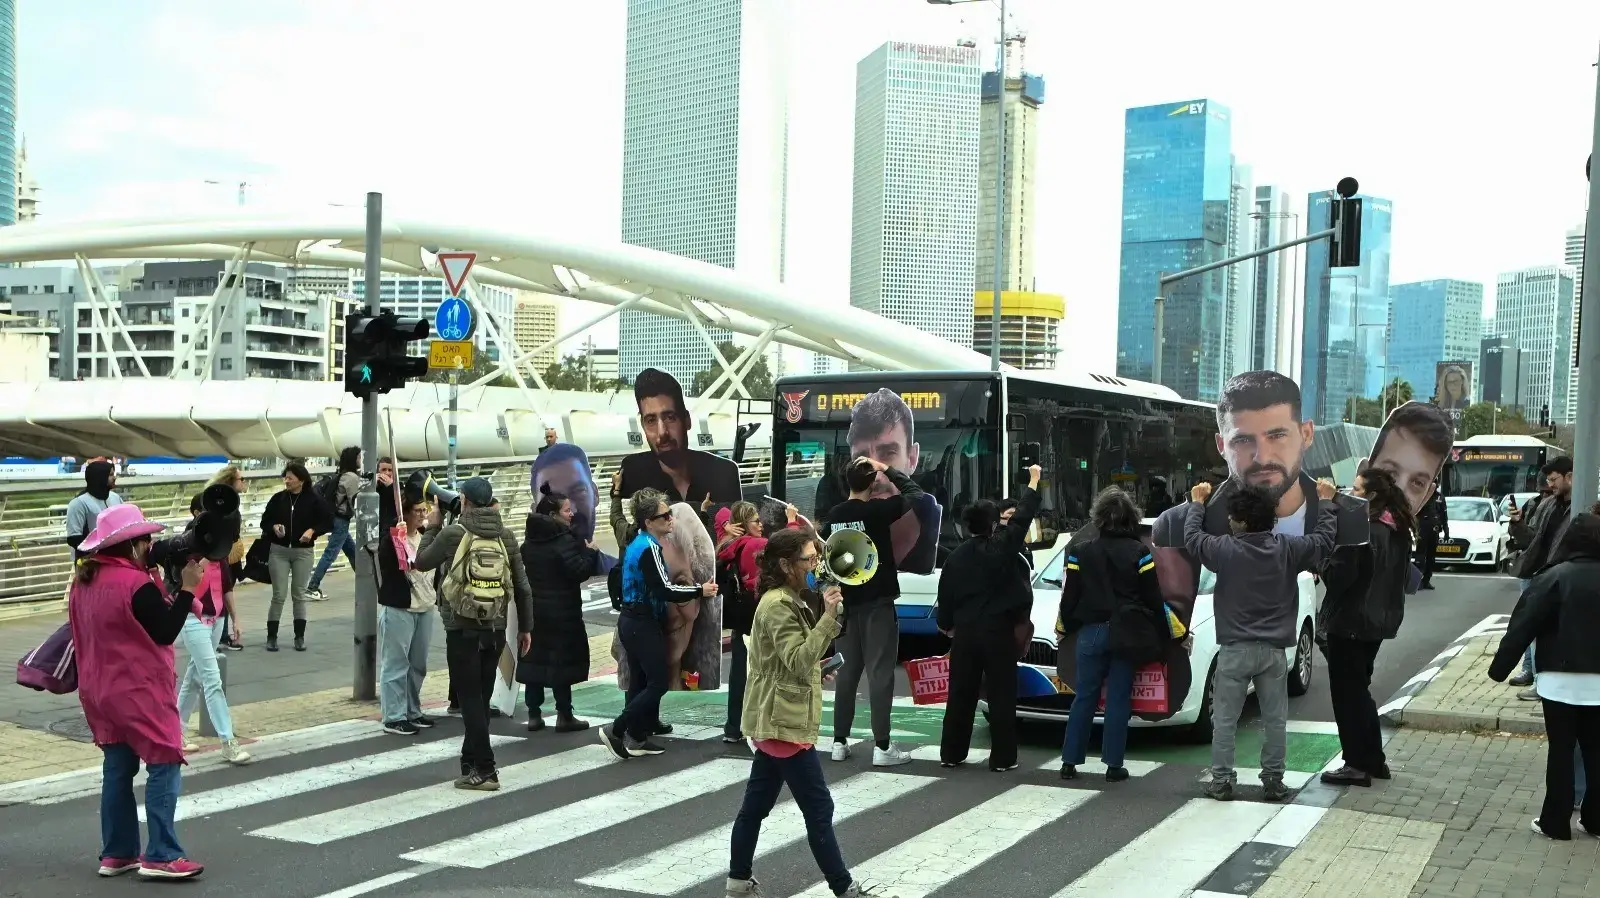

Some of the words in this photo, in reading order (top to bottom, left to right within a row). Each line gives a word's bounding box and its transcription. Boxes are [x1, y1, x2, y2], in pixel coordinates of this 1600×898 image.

[1189, 102, 1205, 114] EY
[442, 345, 460, 353] האט
[630, 434, 641, 442] 60
[916, 679, 949, 694] עזה.
